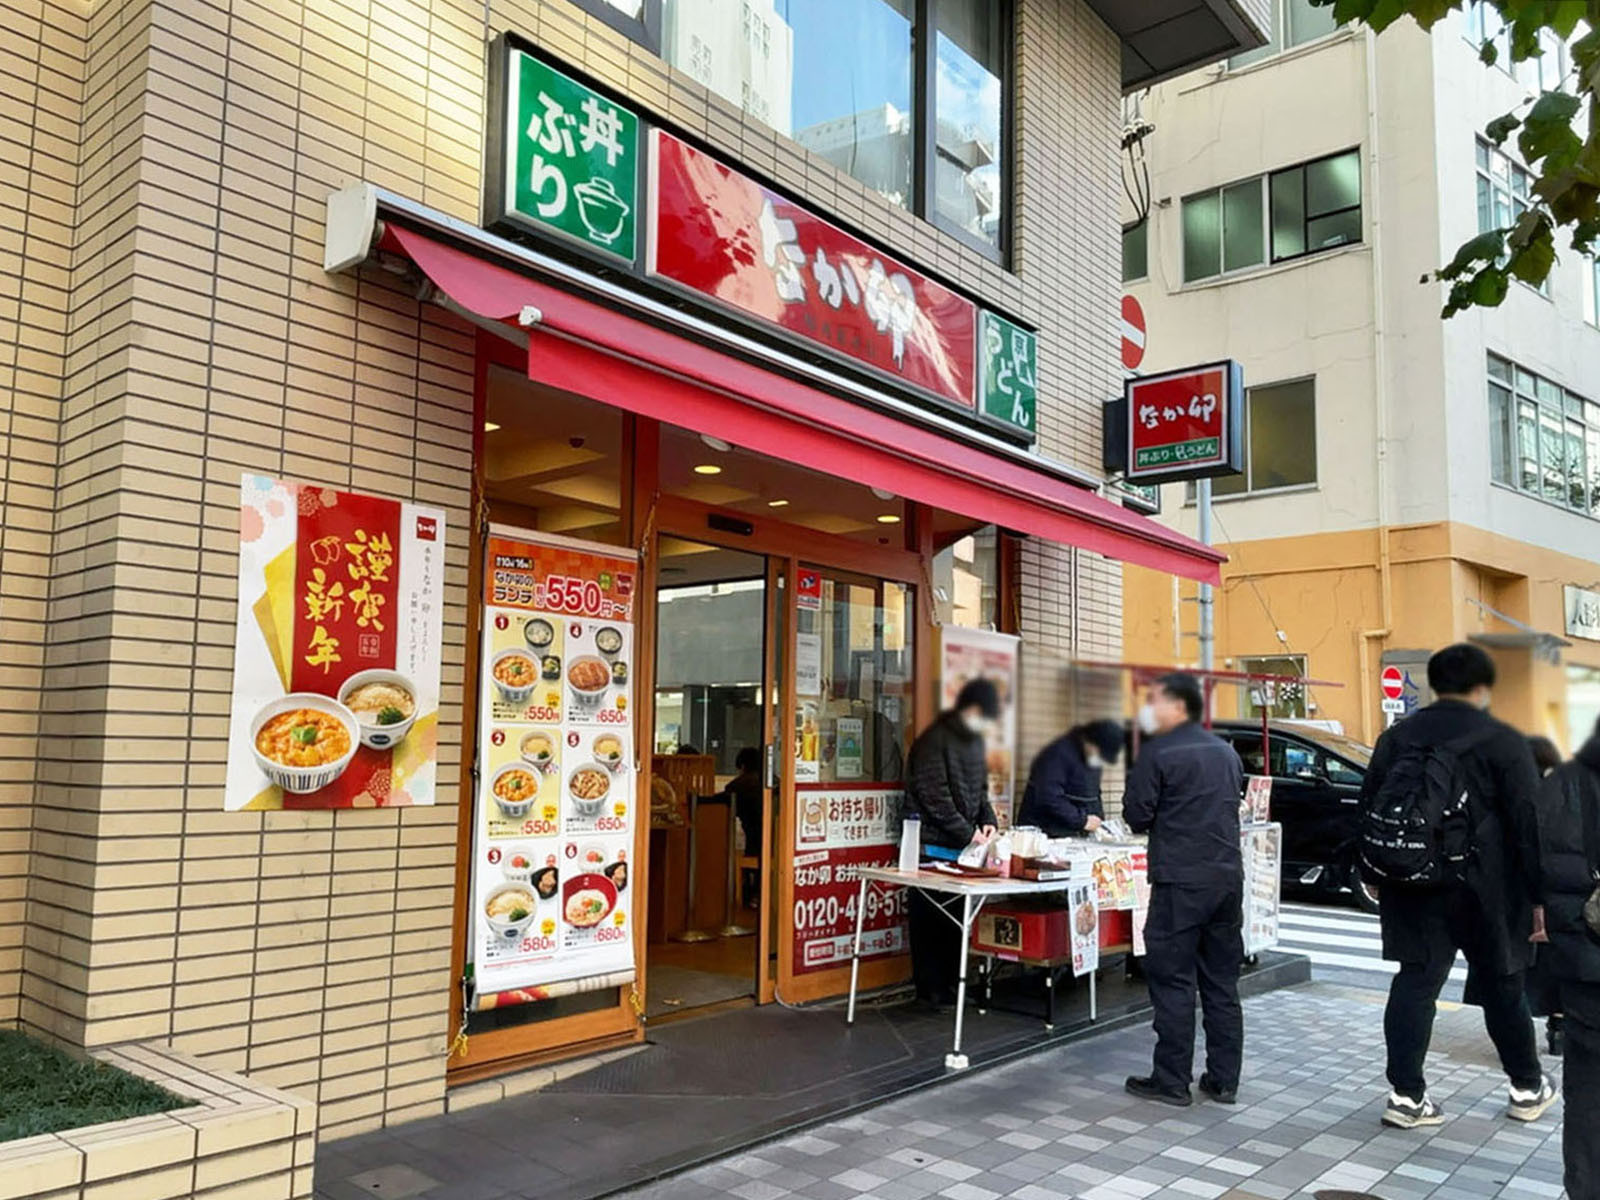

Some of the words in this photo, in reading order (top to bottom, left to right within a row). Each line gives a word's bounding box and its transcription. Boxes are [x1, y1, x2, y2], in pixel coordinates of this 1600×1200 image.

[526, 91, 577, 218] ぶり
[758, 198, 916, 371] なか卯
[1138, 393, 1217, 429] なか卯
[304, 569, 344, 674] 新年
[344, 528, 394, 632] 謹賀
[829, 796, 884, 822] お持ち帰り
[794, 865, 832, 887] なか卯
